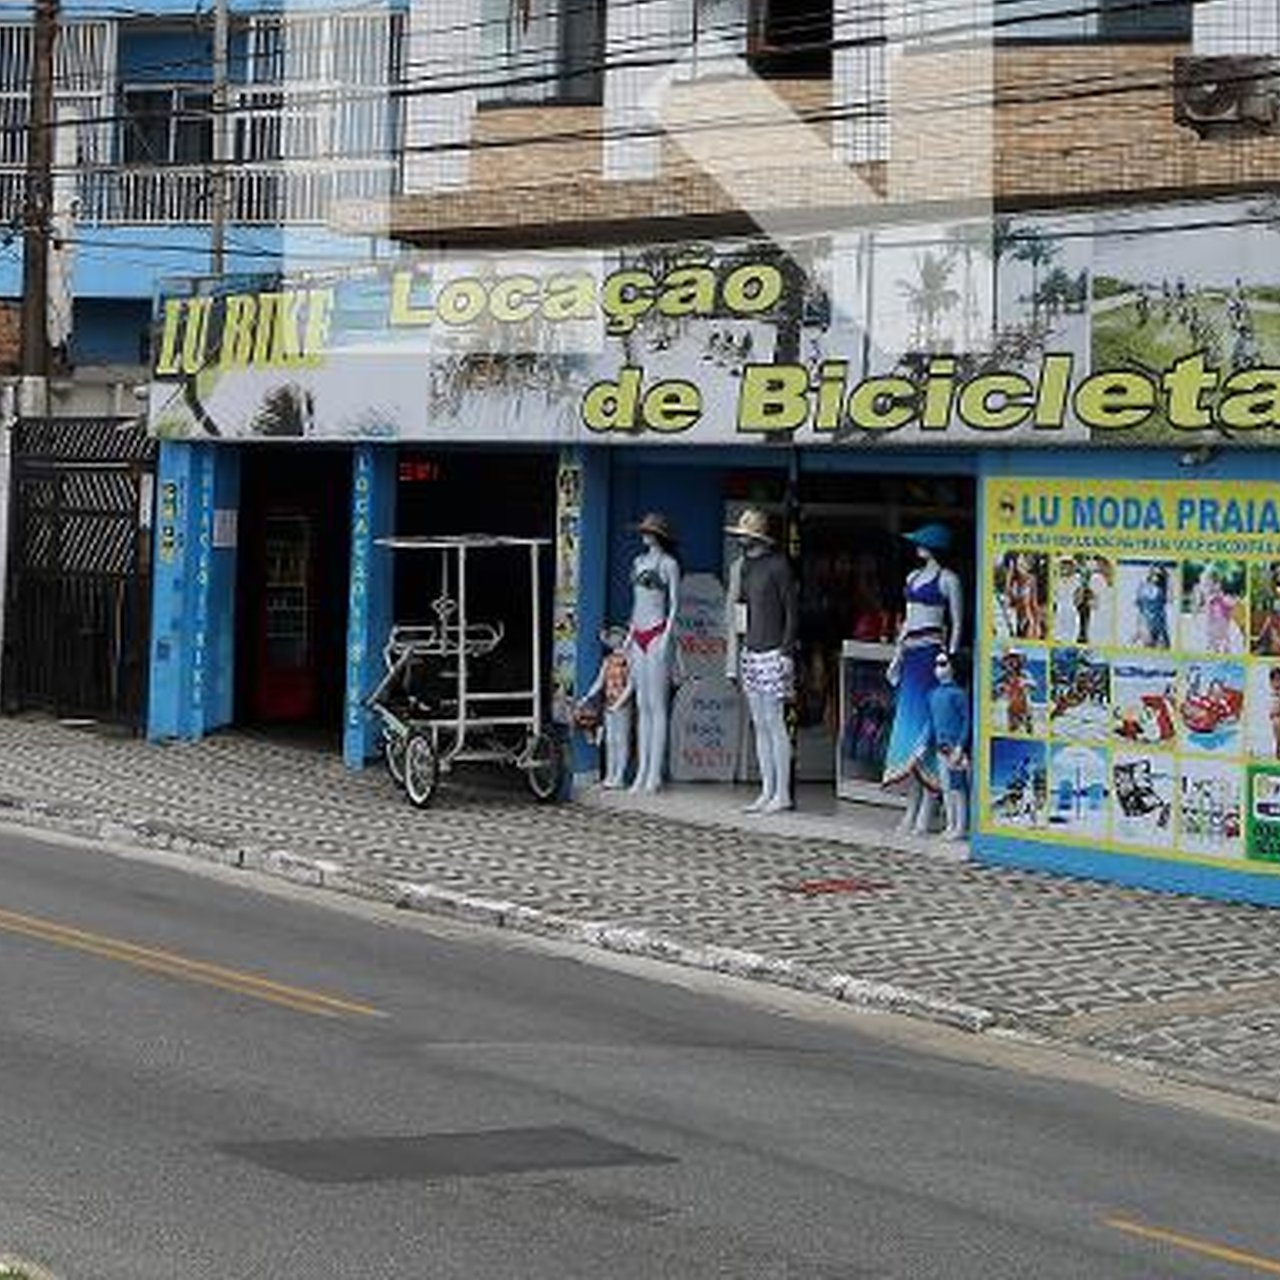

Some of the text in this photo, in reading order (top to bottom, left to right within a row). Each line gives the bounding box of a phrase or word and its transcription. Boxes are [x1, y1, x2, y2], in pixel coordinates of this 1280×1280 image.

[388, 244, 784, 336] Locação
[155, 288, 334, 375] LU BIKE
[581, 365, 703, 434] de
[1021, 494, 1060, 527] LU
[1071, 496, 1166, 531] MODA
